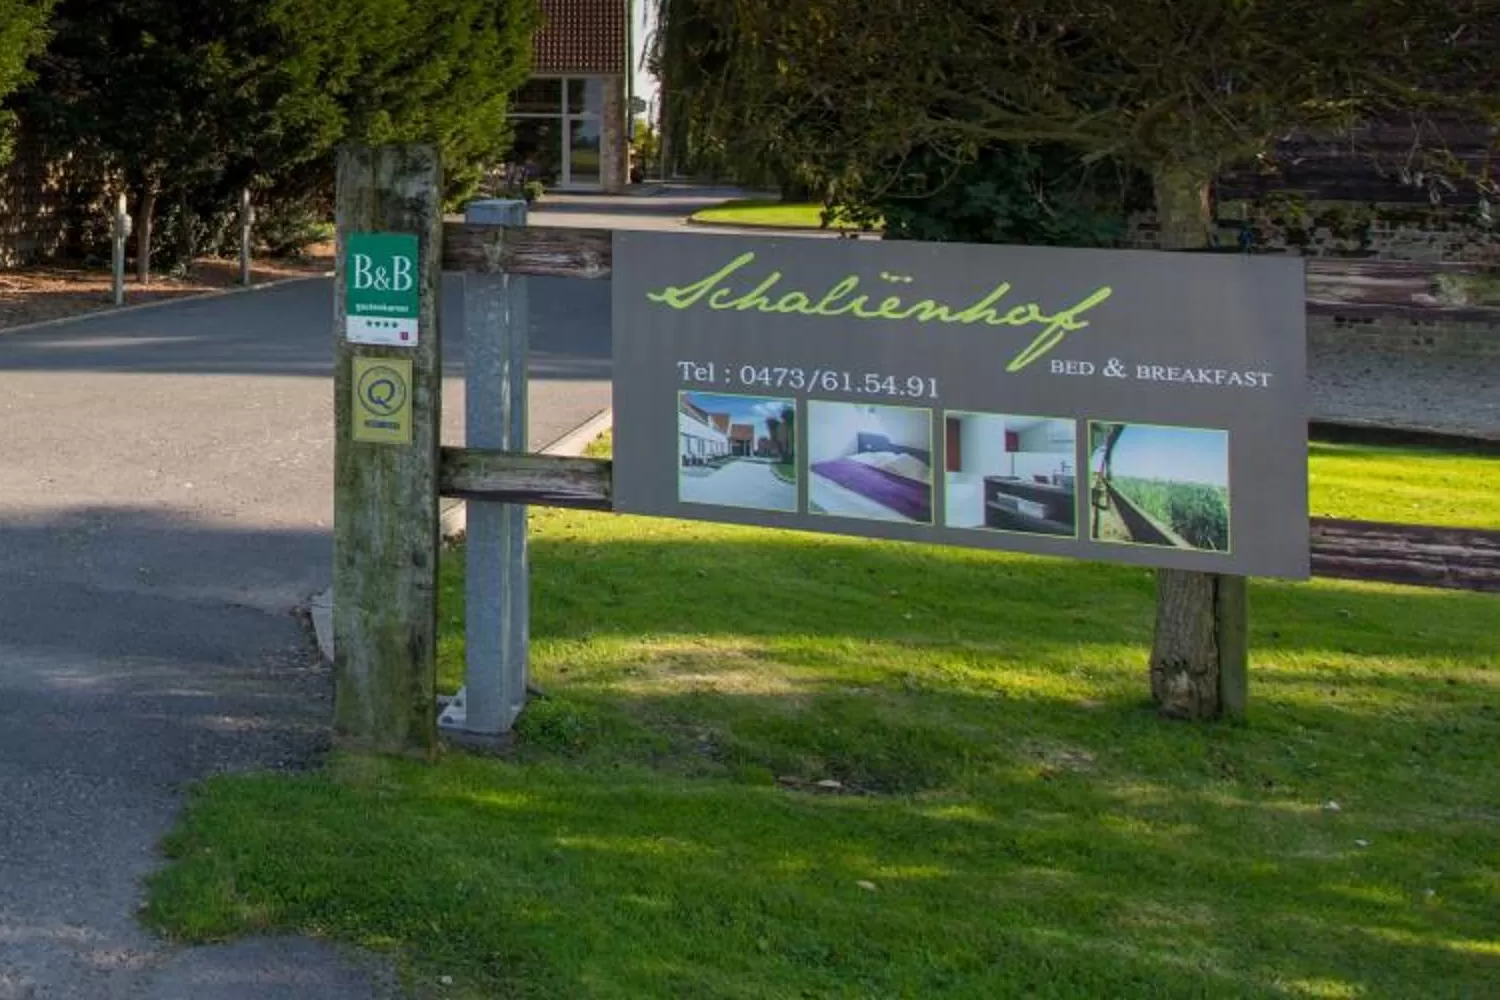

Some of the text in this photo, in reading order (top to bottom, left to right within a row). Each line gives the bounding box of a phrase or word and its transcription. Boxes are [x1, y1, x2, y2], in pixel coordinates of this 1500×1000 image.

[354, 253, 413, 291] B&B
[647, 252, 1111, 372] Schaliënhof
[677, 361, 715, 383] Tel
[739, 365, 939, 398] 0473/61.54.91
[1051, 357, 1273, 388] BED & BREAKFAST
